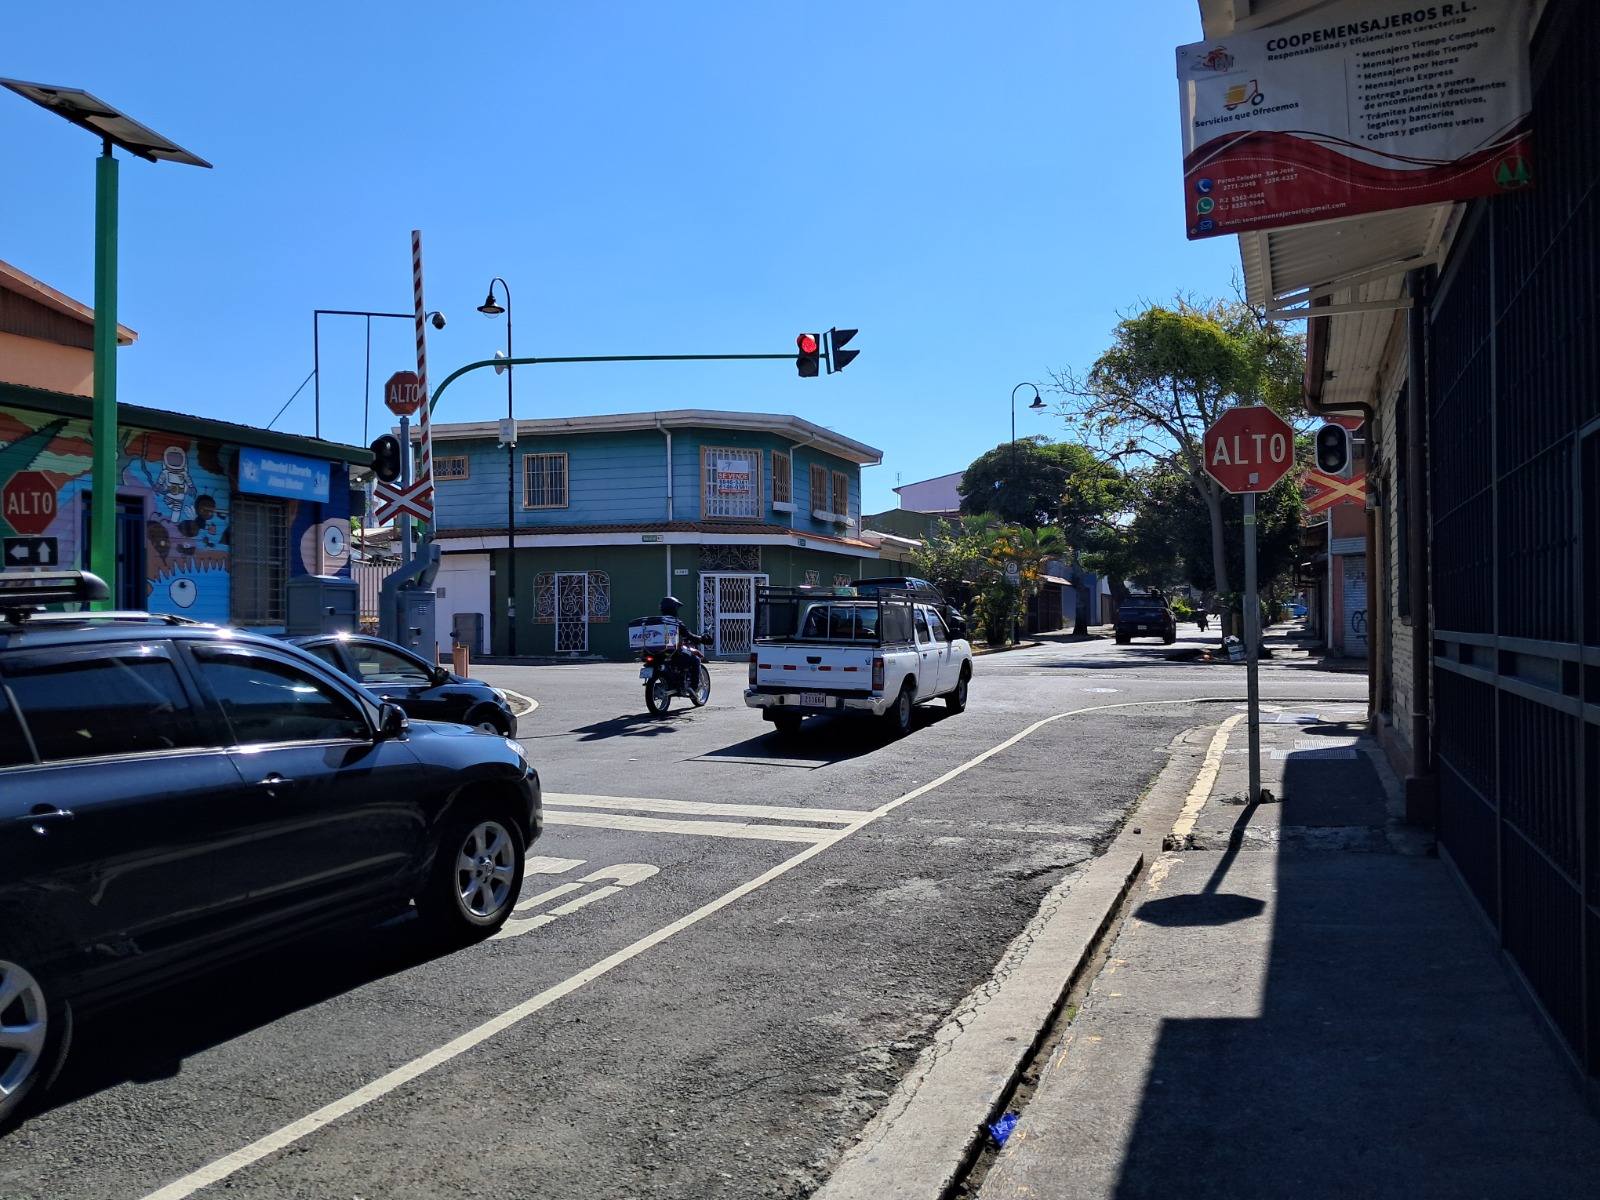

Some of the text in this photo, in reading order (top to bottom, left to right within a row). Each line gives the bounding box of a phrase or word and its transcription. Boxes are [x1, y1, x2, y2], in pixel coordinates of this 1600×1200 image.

[1266, 1, 1477, 51] COOPEMENSAJEROS R.L.
[1268, 42, 1340, 61] Responsabilidad
[1350, 32, 1393, 46] Eficiencia
[1395, 28, 1411, 37] nos
[1414, 16, 1466, 33] caracteriza
[1362, 26, 1495, 58] Mensajero Tiempo Completo
[1362, 41, 1478, 70] Mensajero Medio Tiempo
[1364, 57, 1459, 80] Mensajero por Horas
[1417, 69, 1454, 81] Express
[1364, 81, 1506, 111] de encomiendas y documentos
[1365, 89, 1400, 102] Entrega
[1402, 83, 1434, 96] puerta
[1444, 77, 1475, 89] puerta
[1195, 102, 1299, 128] Servicios que Ofrecemos
[1366, 108, 1406, 121] Trámites
[1367, 110, 1454, 130] legales y bancarios
[1367, 116, 1485, 141] Cobros y gestiones varias
[390, 383, 419, 403] ALTO
[1212, 433, 1286, 466] ALTO
[7, 492, 53, 515] ALTO
